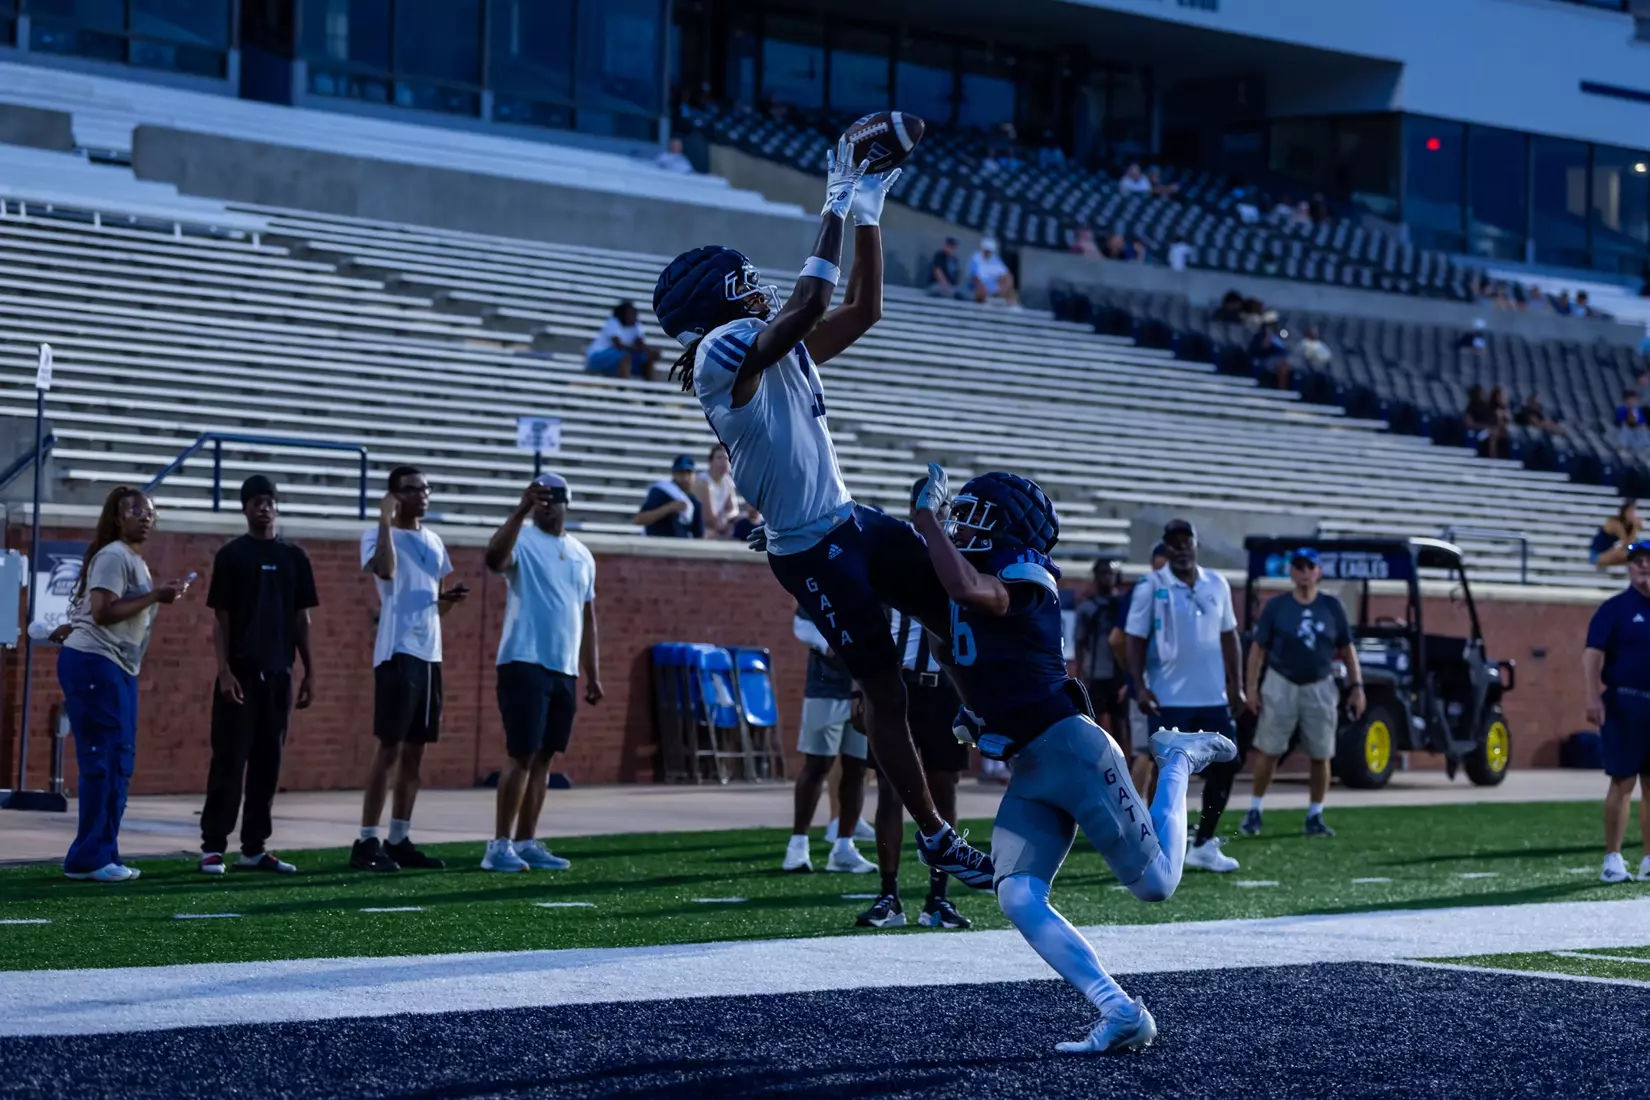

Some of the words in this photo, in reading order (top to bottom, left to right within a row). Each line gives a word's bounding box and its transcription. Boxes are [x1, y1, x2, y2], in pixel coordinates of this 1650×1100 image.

[1340, 560, 1390, 579] EAGLES
[805, 577, 854, 647] GATA
[1104, 767, 1151, 841] GATA
